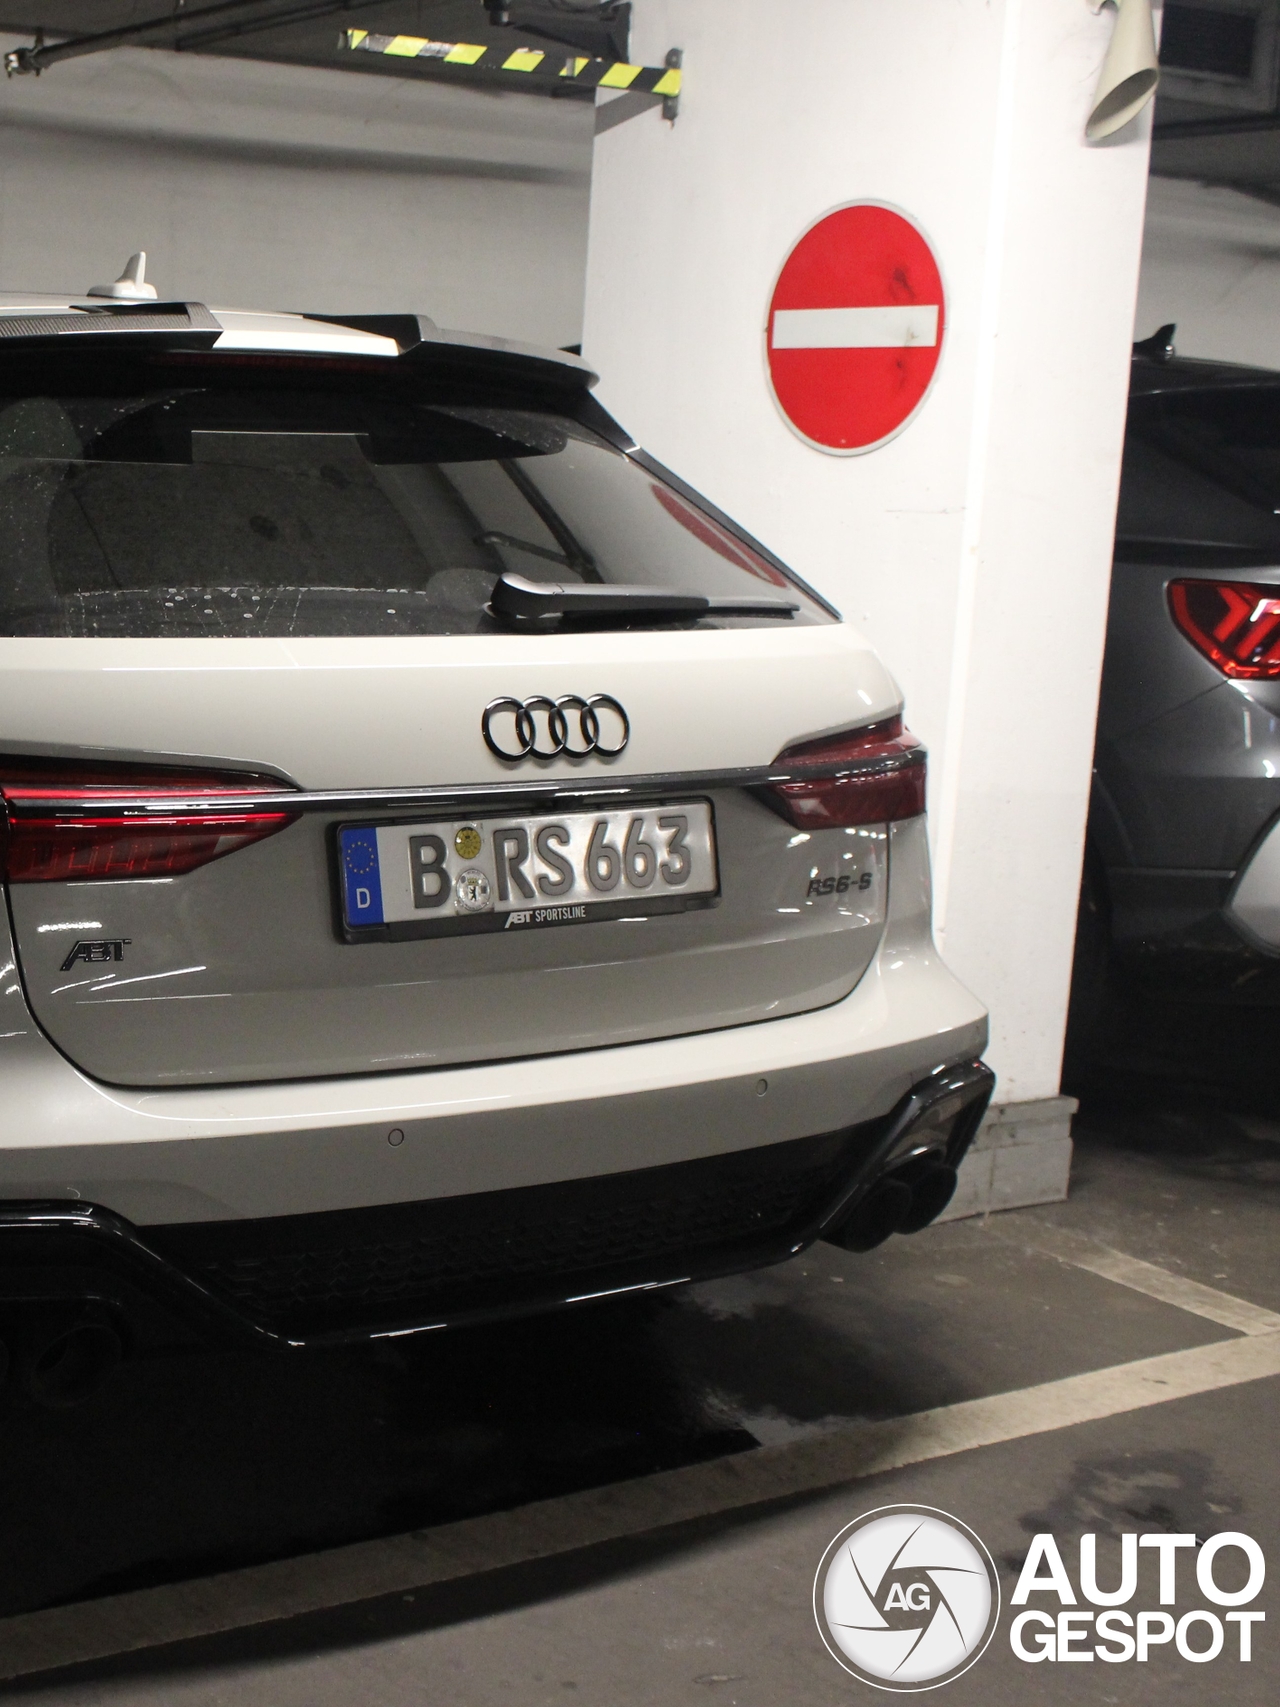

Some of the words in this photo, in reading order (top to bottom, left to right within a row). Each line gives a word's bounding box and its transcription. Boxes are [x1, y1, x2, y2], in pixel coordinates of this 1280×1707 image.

[409, 835, 452, 909] B
[493, 826, 575, 901] RS
[586, 815, 692, 892] 663
[356, 888, 371, 908] D
[806, 872, 873, 898] RS6-S
[504, 911, 533, 929] ABT
[535, 905, 587, 922] SPORTSLINE
[60, 939, 132, 971] ABT
